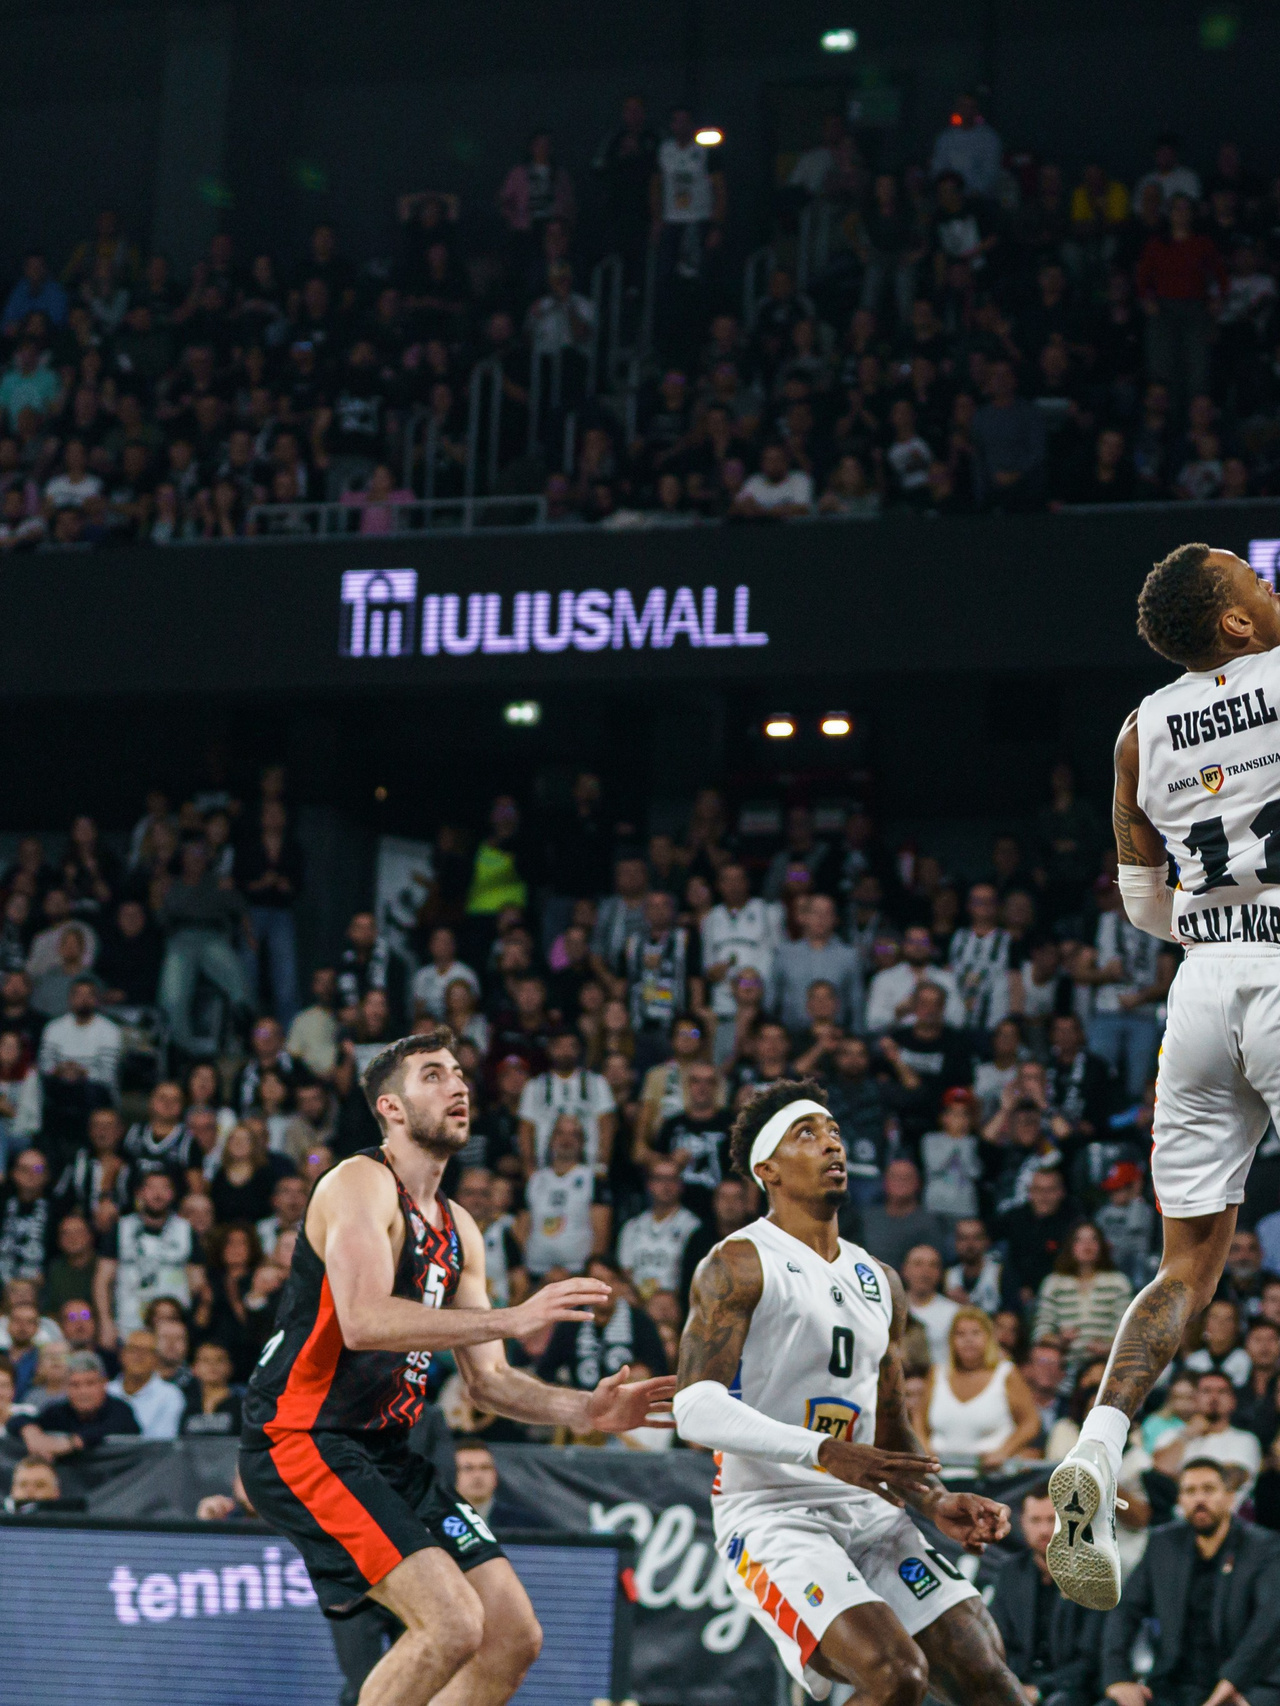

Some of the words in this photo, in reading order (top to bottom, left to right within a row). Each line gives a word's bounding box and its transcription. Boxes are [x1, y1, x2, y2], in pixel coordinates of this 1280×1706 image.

[421, 584, 769, 657] IULIUSMALL
[1166, 688, 1278, 750] RUSSELL
[1168, 776, 1199, 793] BANCA
[1205, 770, 1219, 782] BT
[829, 1325, 855, 1378] 0
[108, 1546, 319, 1625] tennis
